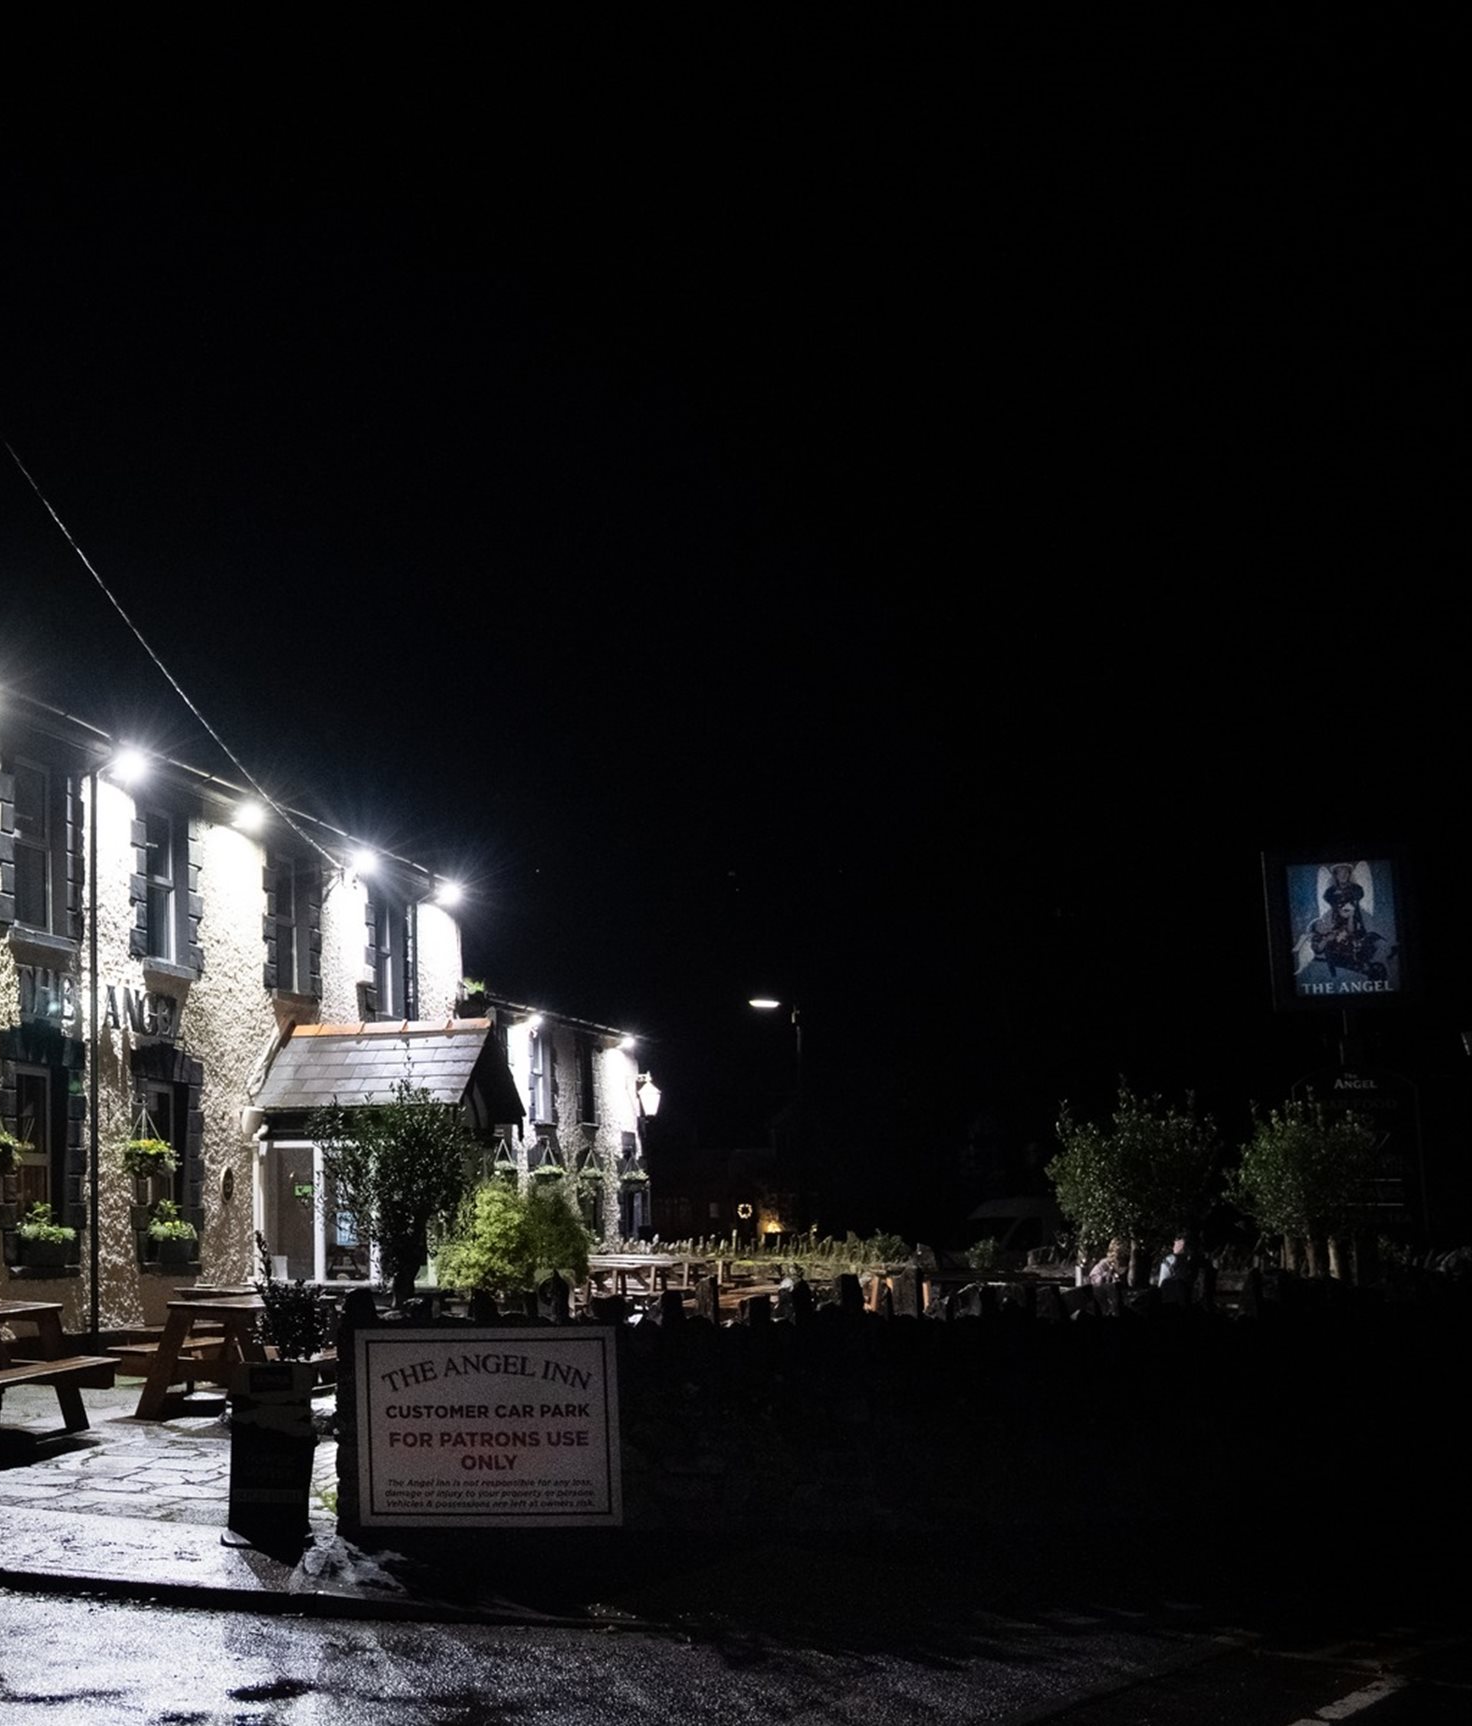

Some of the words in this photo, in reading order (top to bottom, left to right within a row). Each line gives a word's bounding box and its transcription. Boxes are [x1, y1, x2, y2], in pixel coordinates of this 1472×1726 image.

[1302, 982, 1335, 995] THE
[1339, 979, 1395, 993] ANGEL
[1333, 1077, 1379, 1090] ANGEL
[382, 1360, 438, 1392] THE
[444, 1354, 536, 1377] ANGEL
[541, 1360, 592, 1390] INN
[386, 1404, 488, 1419] CUSTOMER
[495, 1404, 534, 1418] CAR
[540, 1403, 590, 1418] PARK
[389, 1432, 432, 1447] FOR
[440, 1431, 540, 1447] PATRONS
[547, 1431, 589, 1446] USE
[461, 1454, 518, 1470] ONLY
[388, 1479, 404, 1487] The
[407, 1479, 434, 1488] Angel
[453, 1479, 460, 1487] is
[463, 1479, 479, 1487] not
[537, 1479, 551, 1487] for
[553, 1480, 570, 1488] any
[385, 1490, 422, 1499] damage
[436, 1490, 463, 1499] injury
[478, 1490, 500, 1499] your
[501, 1490, 541, 1499] property
[386, 1500, 423, 1508] Vehicles
[510, 1500, 527, 1508] left
